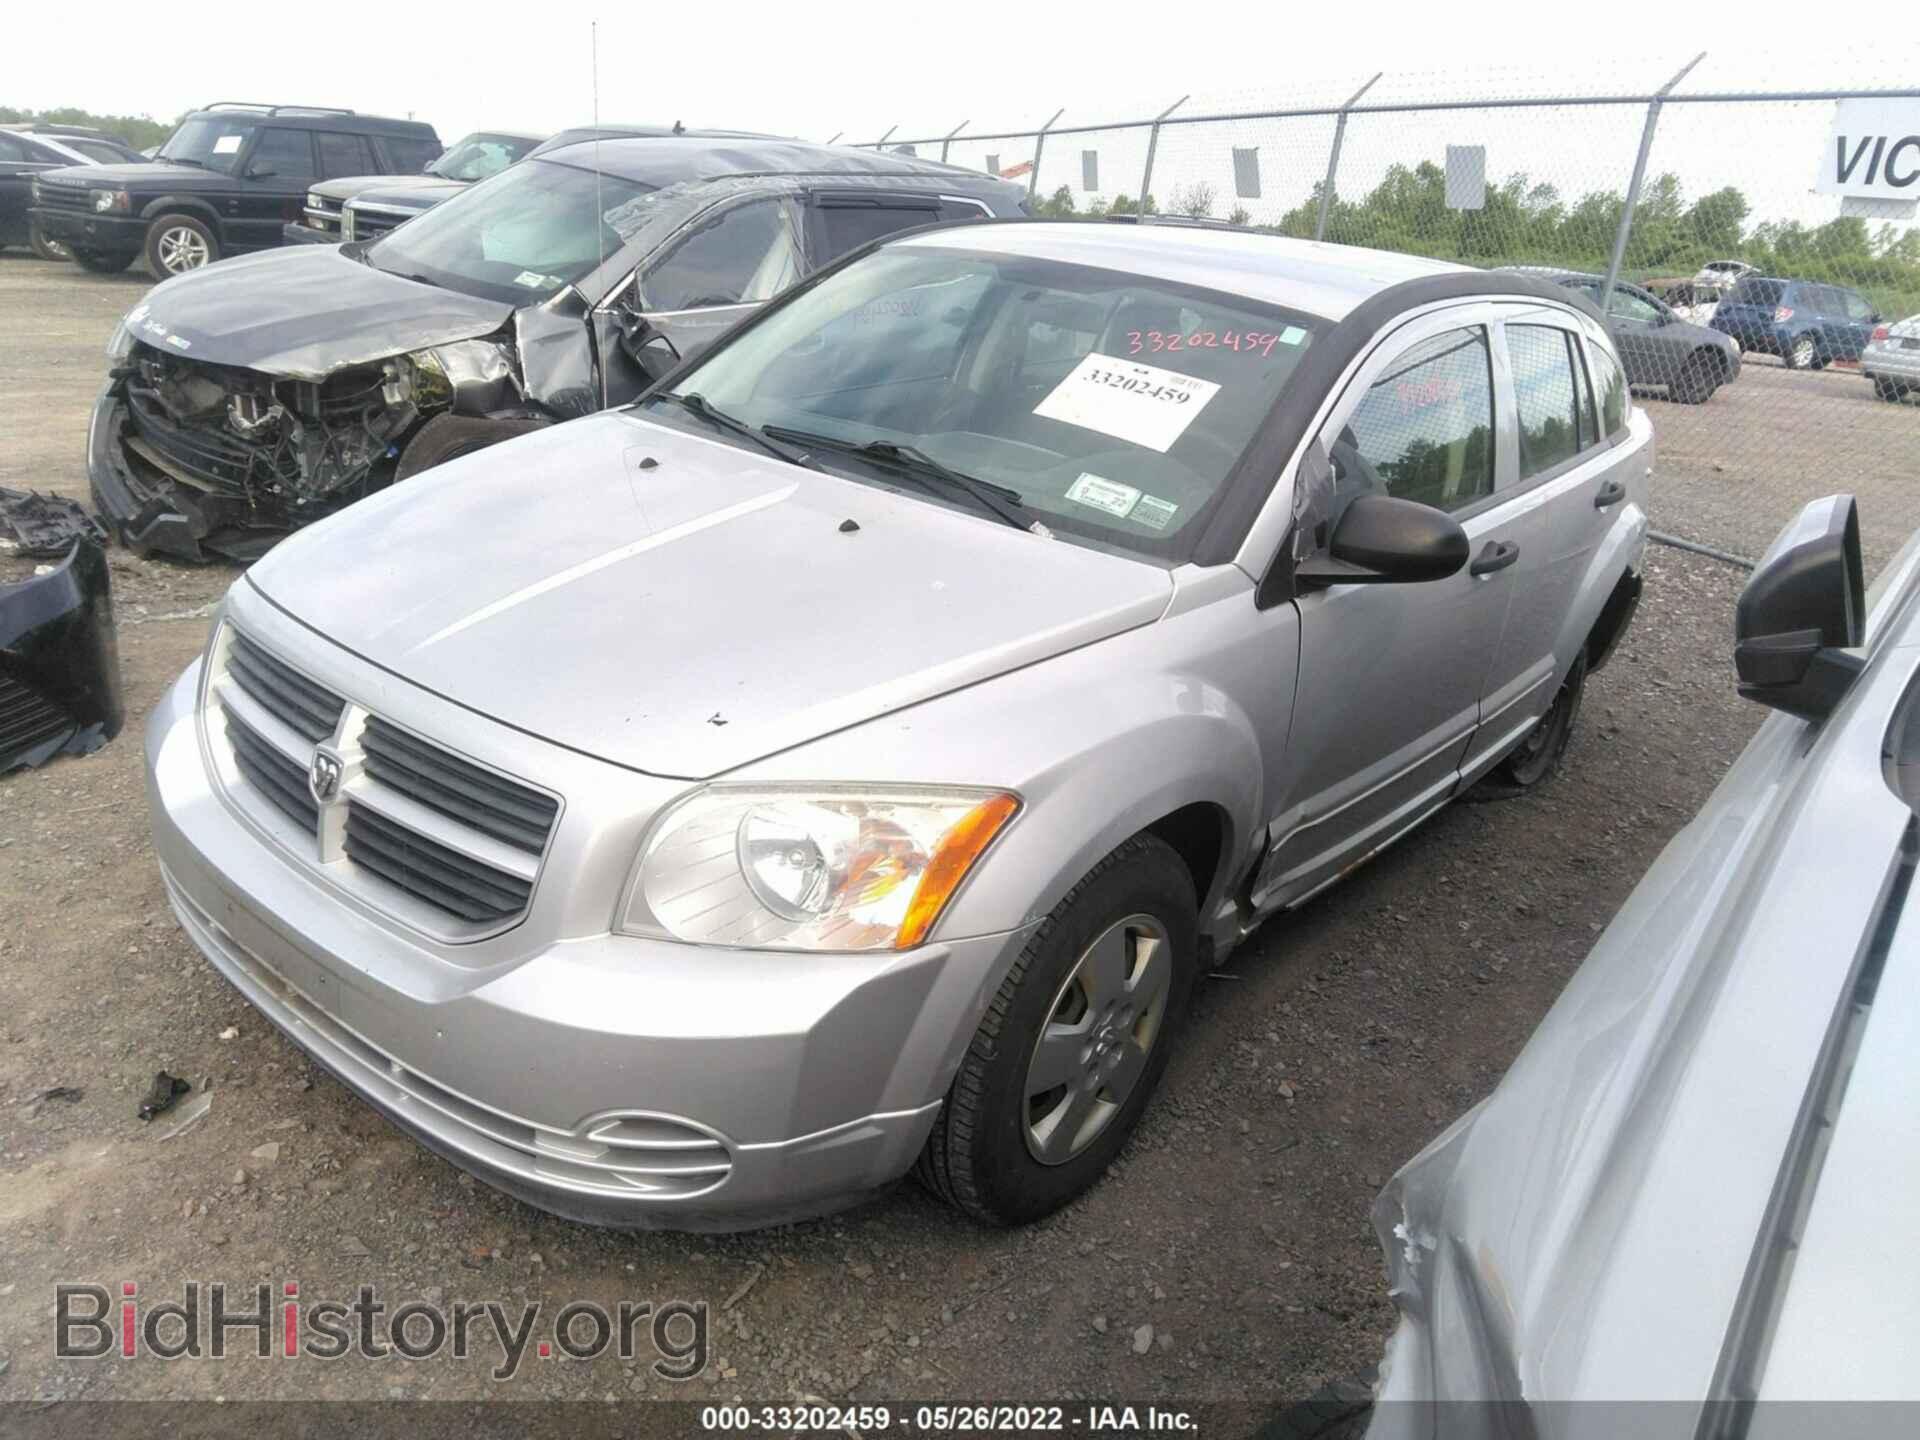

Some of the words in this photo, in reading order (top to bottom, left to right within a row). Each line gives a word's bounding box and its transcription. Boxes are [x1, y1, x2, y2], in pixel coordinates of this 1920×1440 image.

[1836, 135, 1920, 188] VIC
[1127, 329, 1278, 357] 33202459
[1083, 368, 1191, 405] 33202459
